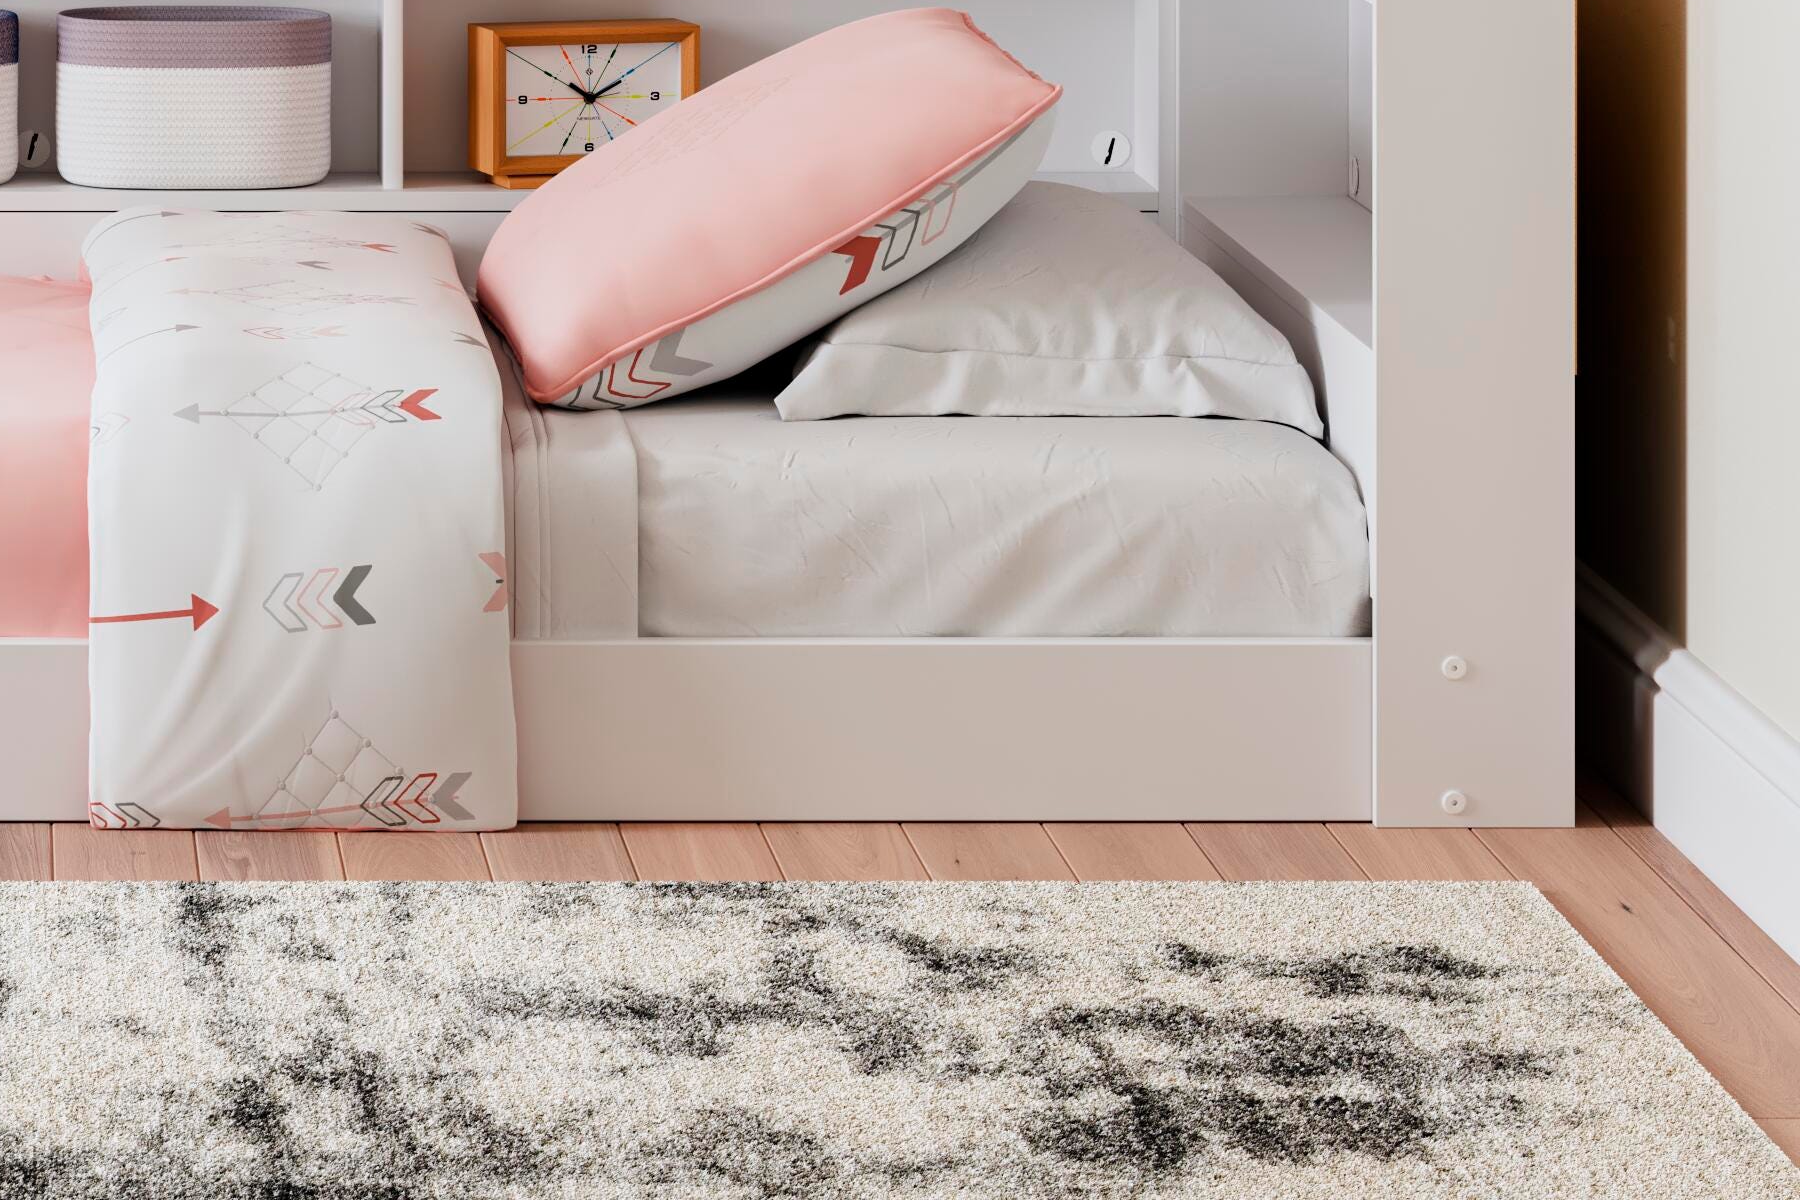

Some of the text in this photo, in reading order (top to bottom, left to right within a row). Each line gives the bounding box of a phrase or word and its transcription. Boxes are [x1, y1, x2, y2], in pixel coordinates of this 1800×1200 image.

[581, 44, 597, 54] 12
[518, 95, 528, 104] 9
[650, 91, 660, 101] 3
[584, 142, 594, 152] 6
